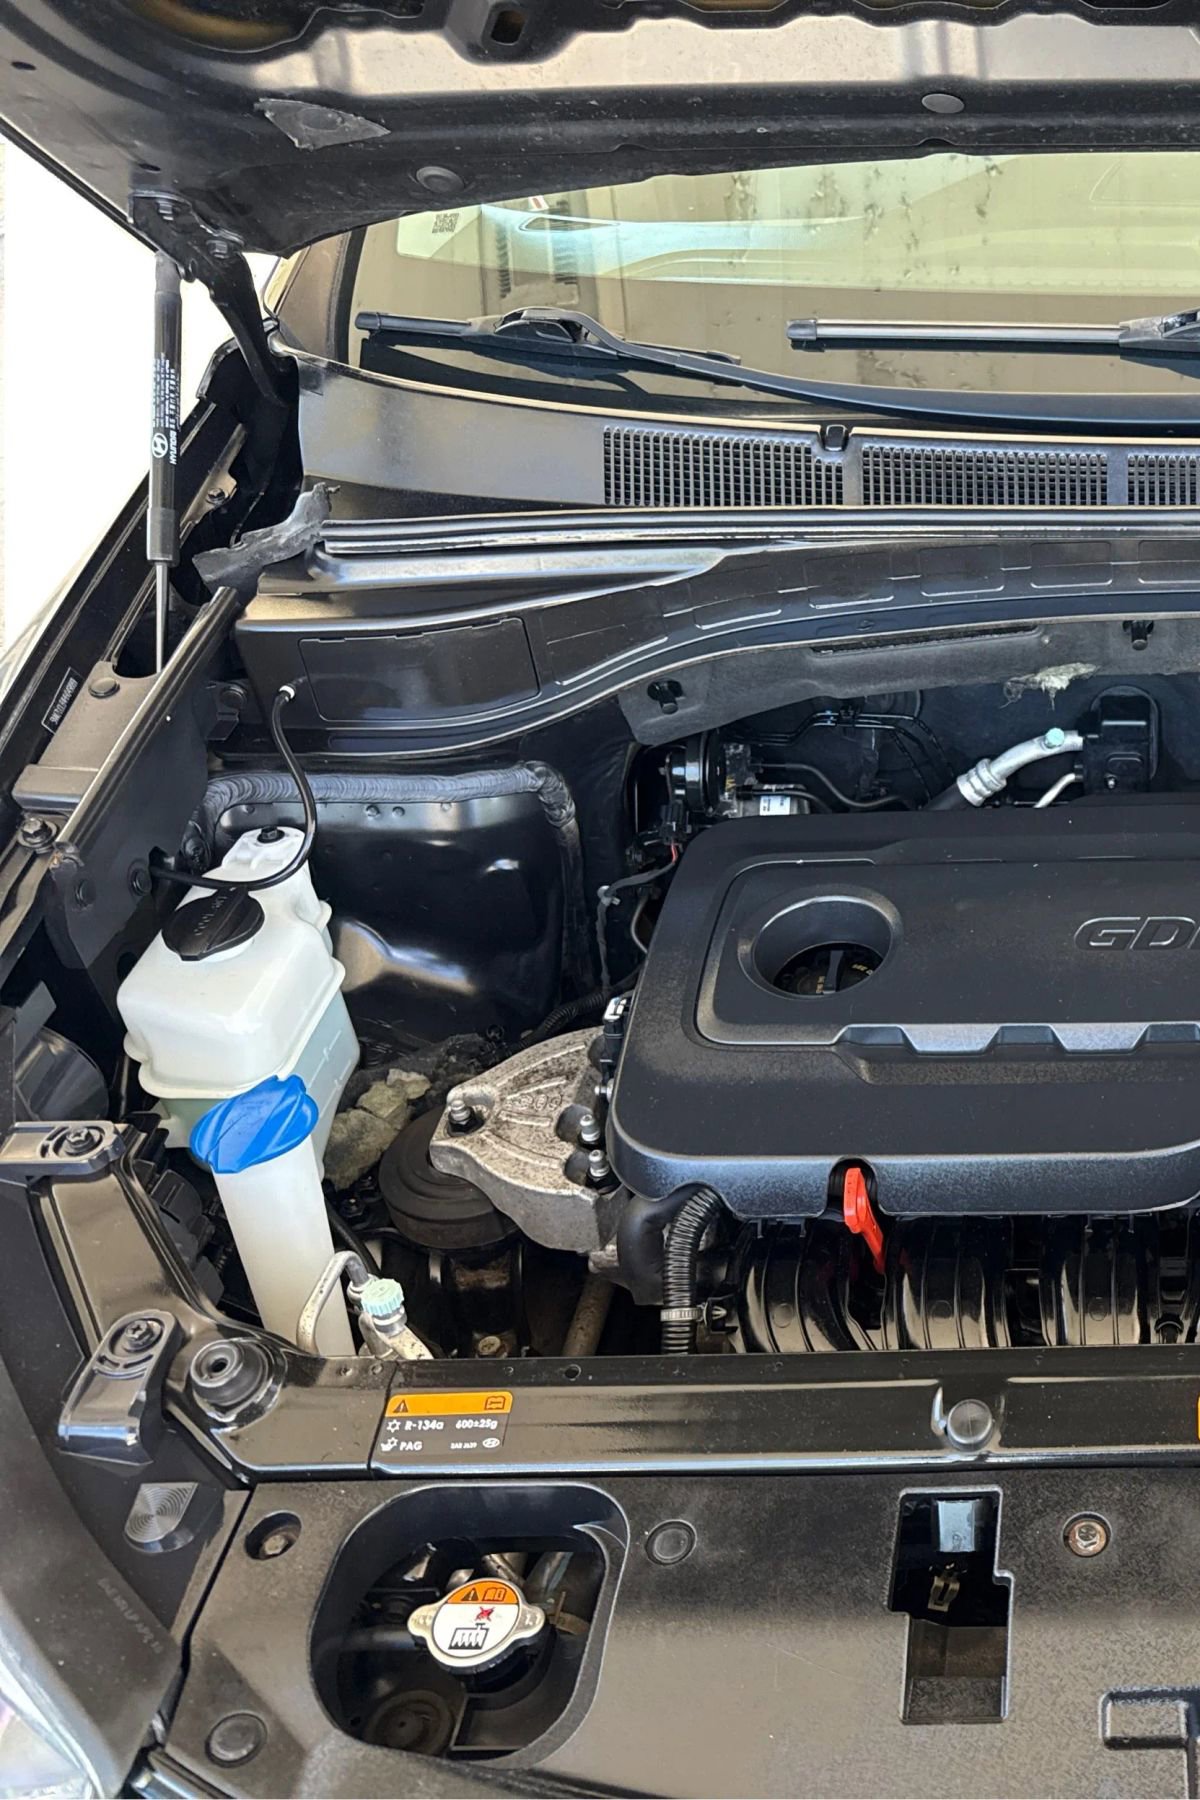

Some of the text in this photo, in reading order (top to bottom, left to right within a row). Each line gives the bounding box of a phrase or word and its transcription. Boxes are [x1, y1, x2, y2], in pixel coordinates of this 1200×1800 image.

[169, 431, 178, 465] HYUNDAI
[404, 1418, 498, 1431] R-134a 600±25g
[399, 1441, 423, 1452] PAG
